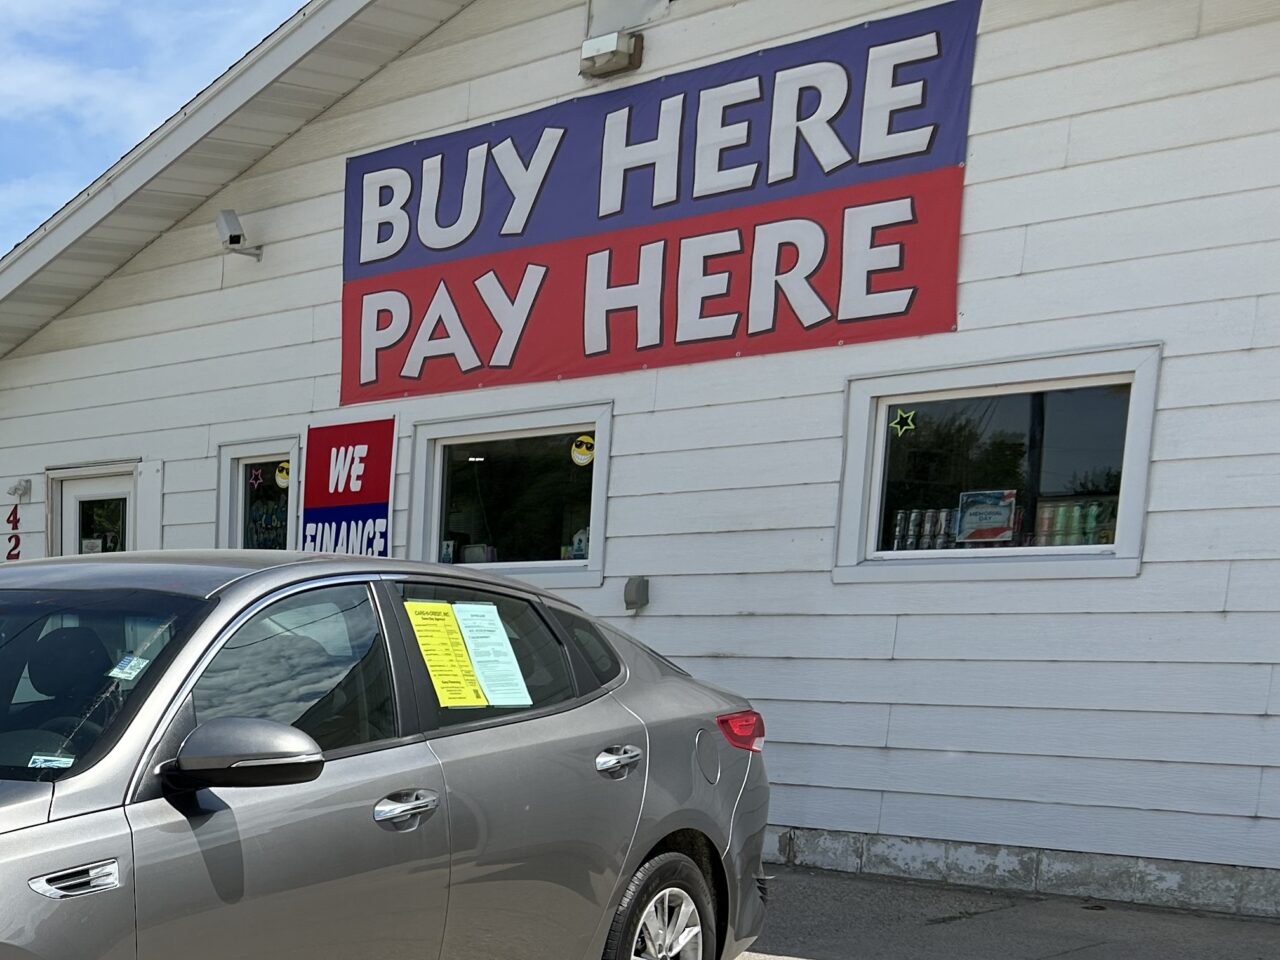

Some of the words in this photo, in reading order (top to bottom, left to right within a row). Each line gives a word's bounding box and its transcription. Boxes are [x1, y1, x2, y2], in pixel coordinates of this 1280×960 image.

[359, 127, 566, 265] BUY
[598, 31, 940, 219] HERE
[359, 261, 548, 386] PAY
[584, 197, 916, 357] HERE
[328, 444, 369, 494] WE
[304, 518, 387, 556] FINANCE
